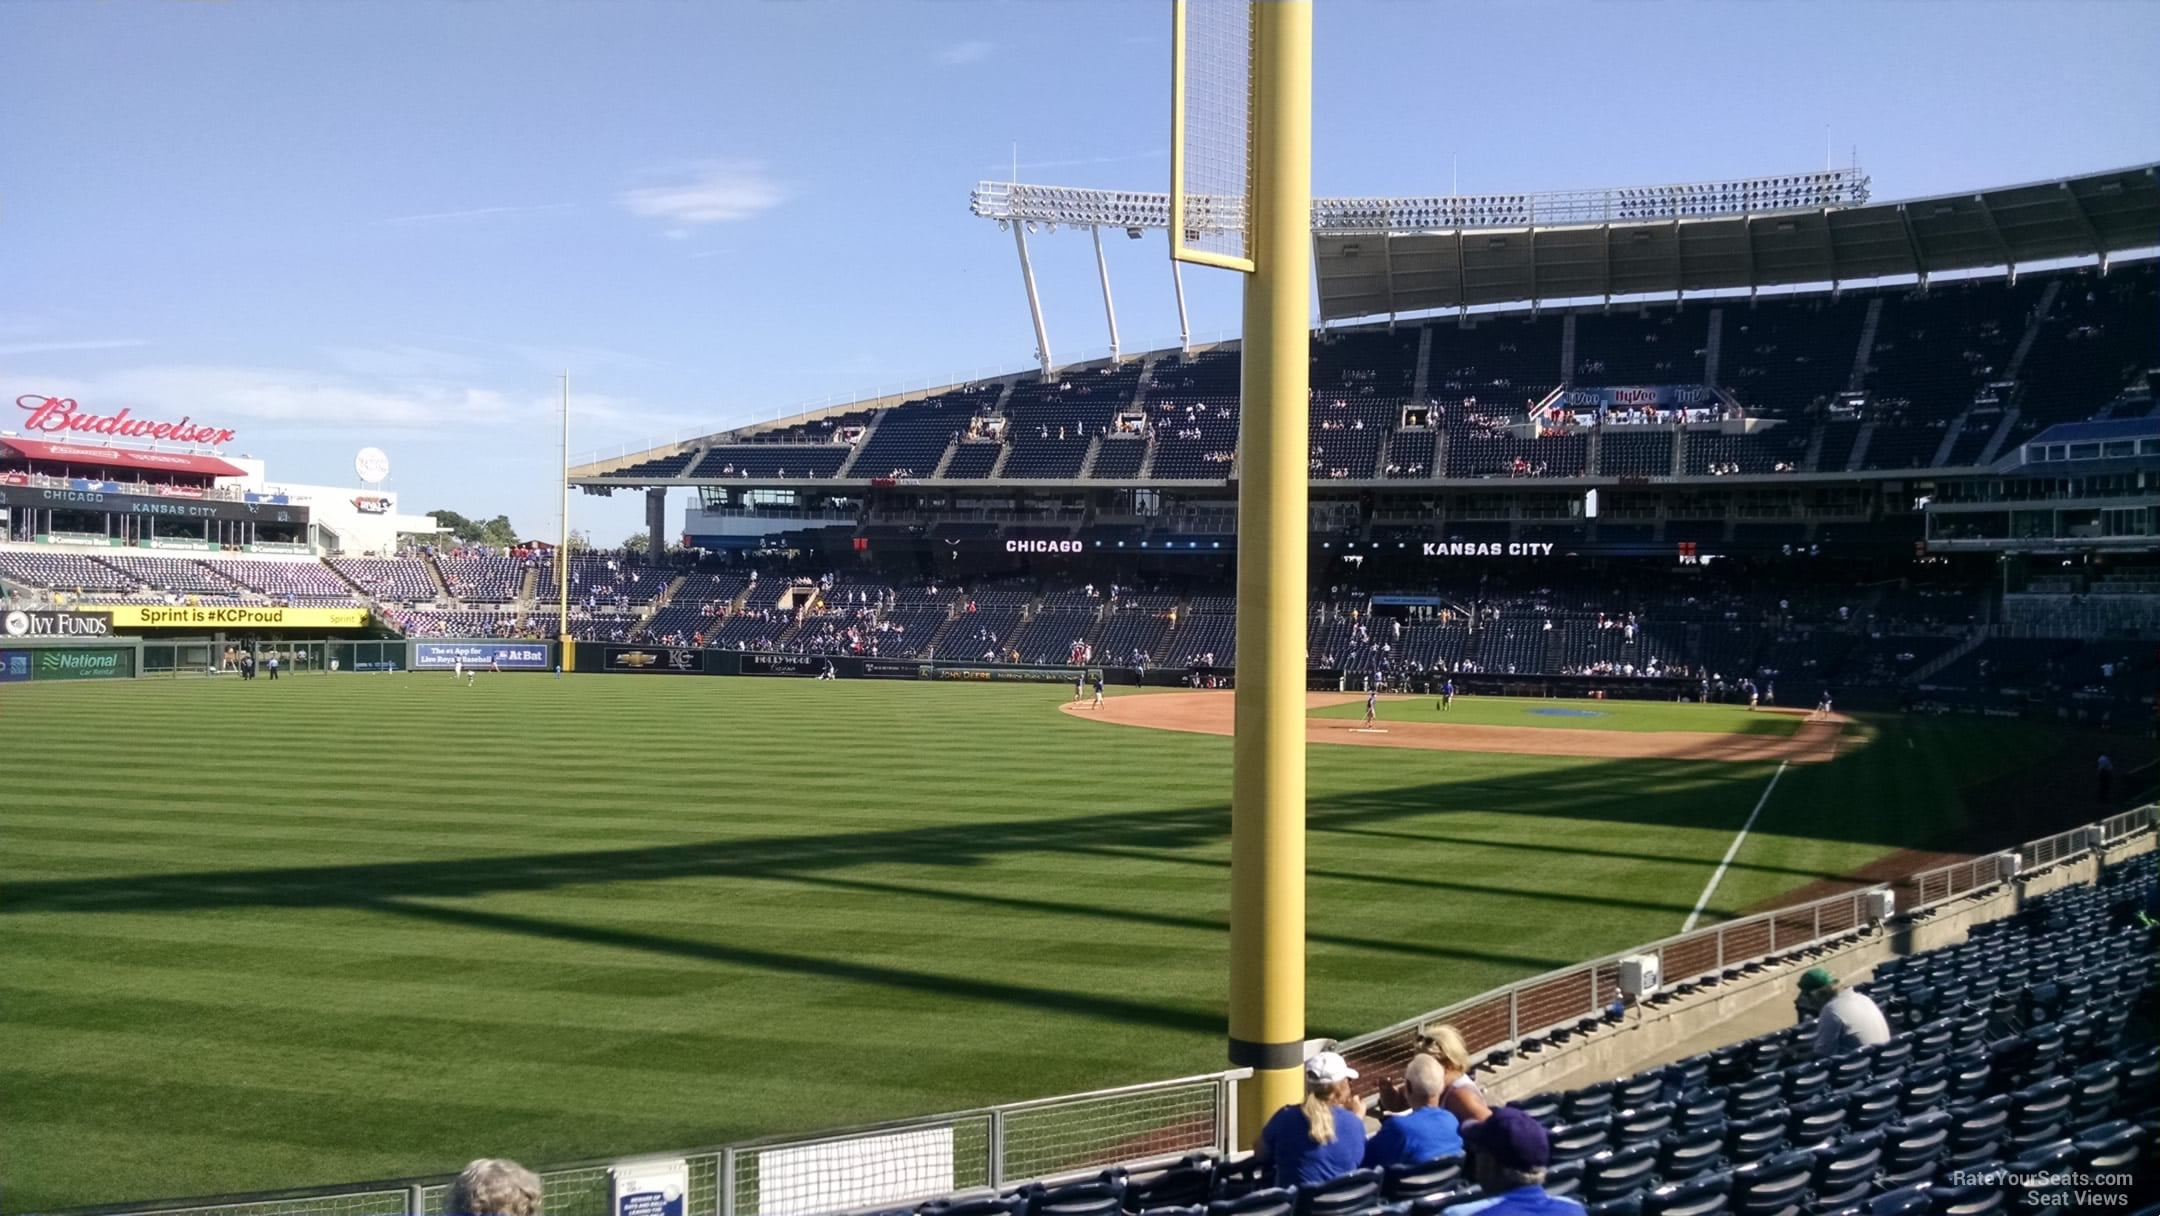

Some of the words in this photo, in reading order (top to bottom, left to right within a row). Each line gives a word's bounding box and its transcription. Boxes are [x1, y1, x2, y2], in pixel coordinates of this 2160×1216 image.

[1616, 388, 1657, 404] HyVee
[16, 394, 236, 445] Budweiser
[43, 490, 104, 503] CHICAGO
[132, 503, 186, 515] KANSAS
[189, 507, 217, 517] CITY
[1006, 540, 1083, 553] CHICAGO
[1423, 543, 1502, 556] KANSAS
[1508, 543, 1553, 556] CITY
[140, 608, 189, 624] Sprint
[192, 610, 205, 622] is
[208, 610, 283, 623] #KCProud
[330, 614, 355, 624] Sprint
[29, 613, 55, 634] IVY
[57, 613, 107, 634] FUNDS
[454, 648, 469, 656] App
[509, 651, 523, 661] At
[524, 651, 542, 661] Bat
[60, 653, 118, 668] National
[754, 656, 812, 665] HOLLYWOOD
